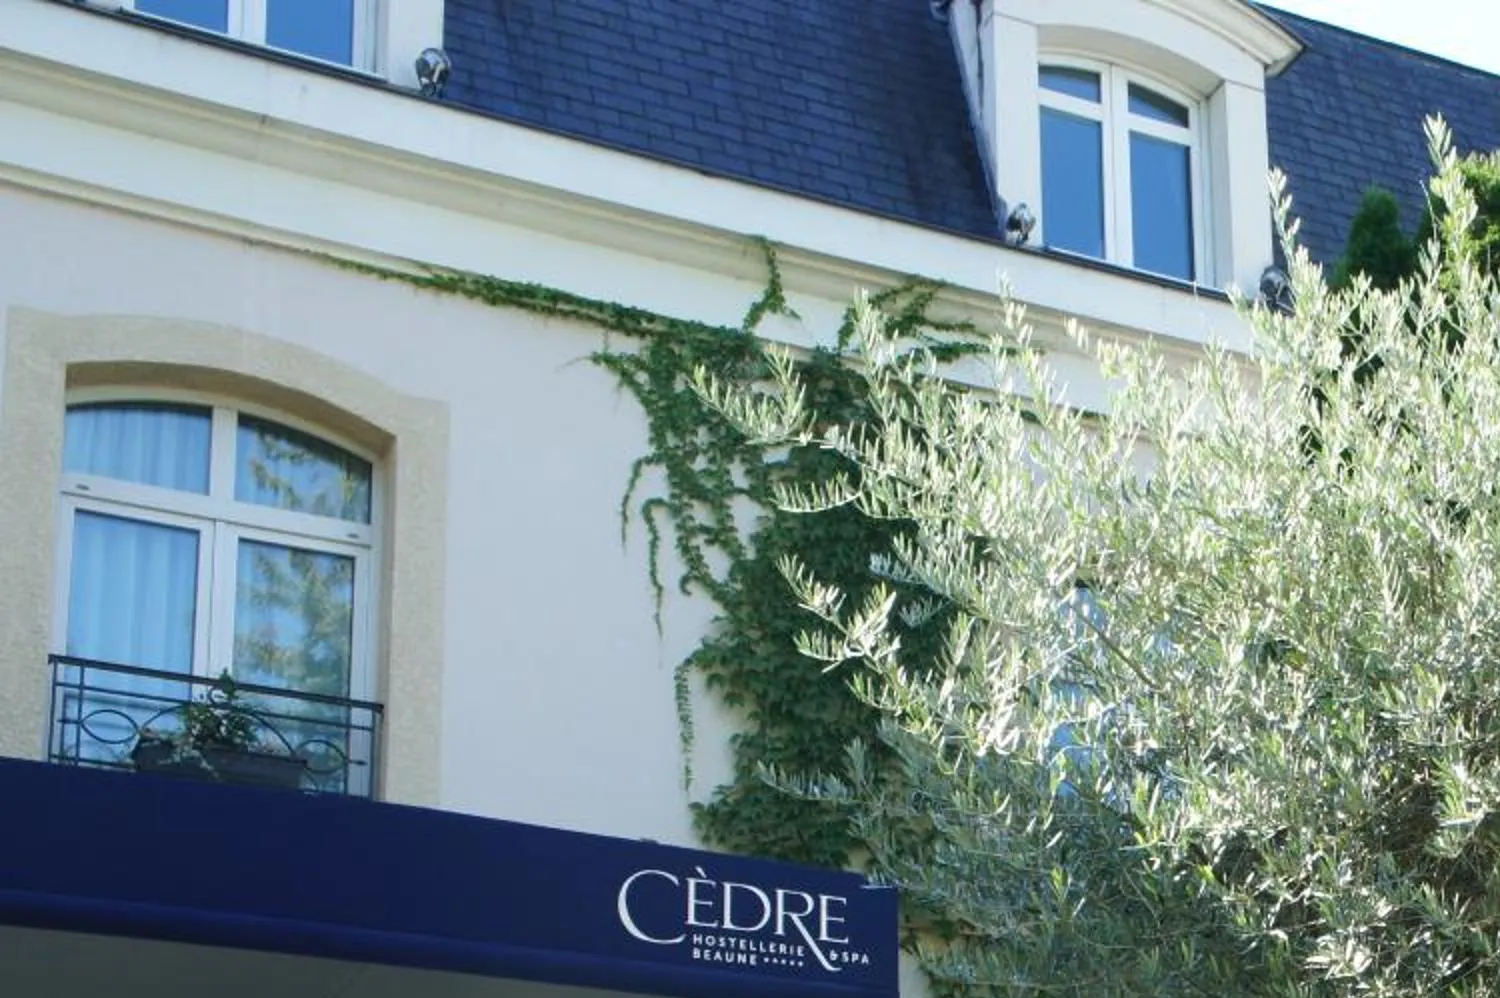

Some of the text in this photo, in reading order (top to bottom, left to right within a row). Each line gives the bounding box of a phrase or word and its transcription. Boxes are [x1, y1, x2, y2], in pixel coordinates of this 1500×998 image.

[617, 866, 849, 971] CÈDRE
[692, 947, 757, 966] BEAUNE
[693, 933, 805, 957] HOSTELLERIE
[841, 951, 869, 965] SPA
